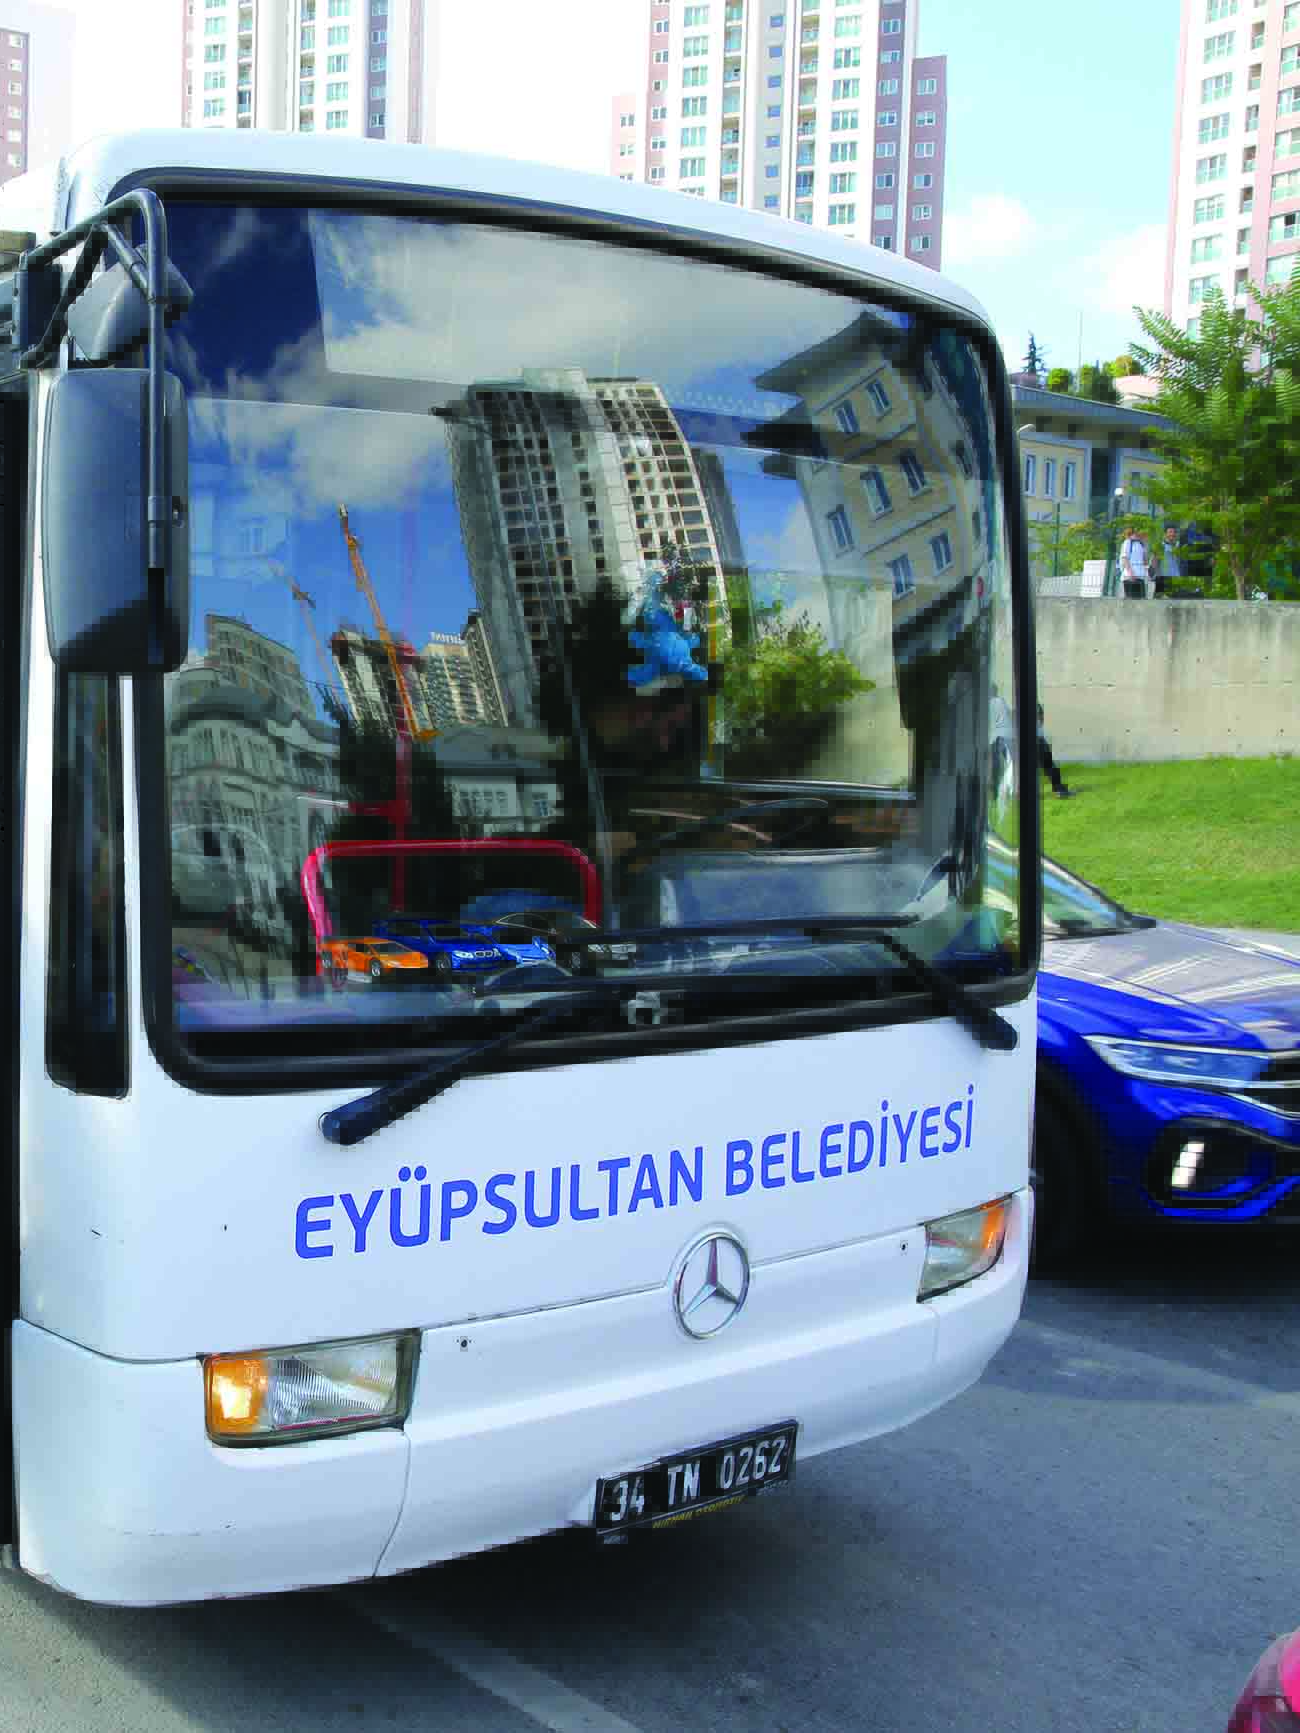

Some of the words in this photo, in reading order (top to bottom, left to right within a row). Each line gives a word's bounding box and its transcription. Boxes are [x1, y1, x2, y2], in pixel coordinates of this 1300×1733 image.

[294, 1146, 704, 1260] EYÜPSULTAN
[725, 1083, 974, 1196] BELEDİYESİ
[609, 1477, 646, 1522] 34
[667, 1461, 701, 1506] TN
[718, 1435, 788, 1490] 0262
